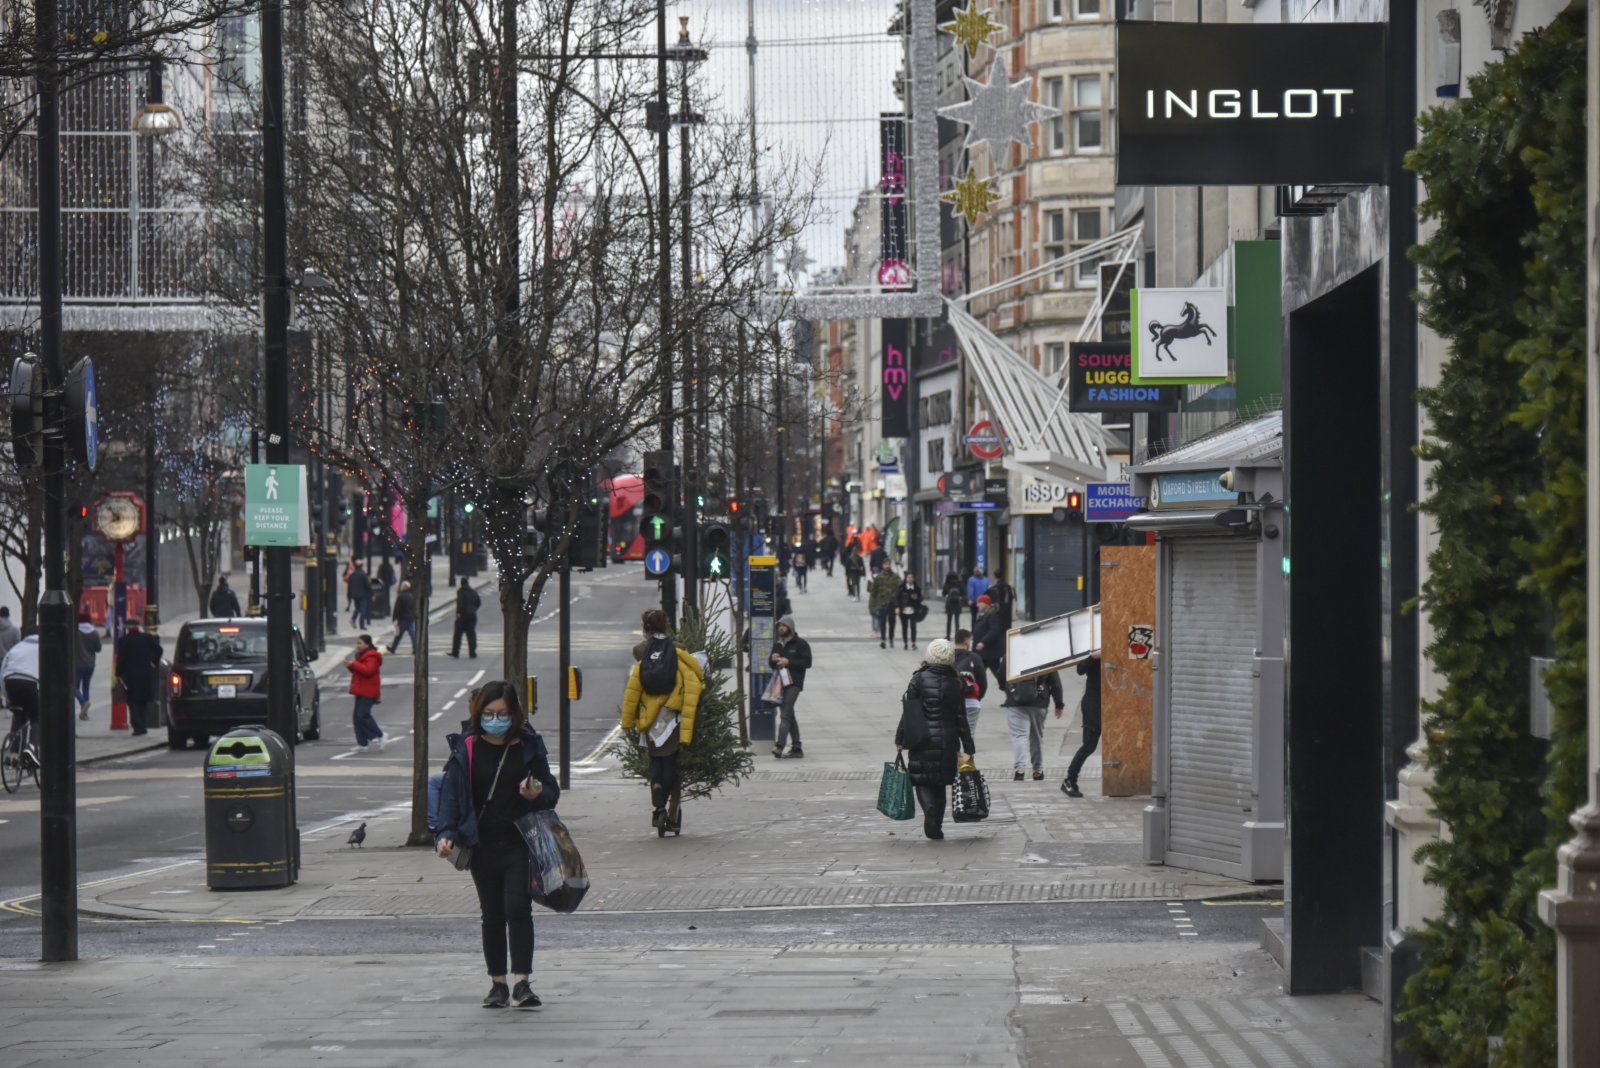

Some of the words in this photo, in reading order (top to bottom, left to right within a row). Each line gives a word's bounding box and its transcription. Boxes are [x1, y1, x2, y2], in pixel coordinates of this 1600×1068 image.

[1147, 89, 1354, 119] INGLOT
[1078, 353, 1131, 367] SOUVE
[884, 344, 907, 401] hmv
[1085, 371, 1132, 384] LUGG
[1088, 388, 1160, 401] FASHION
[1097, 486, 1131, 496] MONE
[1163, 481, 1185, 496] OXFORD
[1187, 479, 1210, 494] STREET
